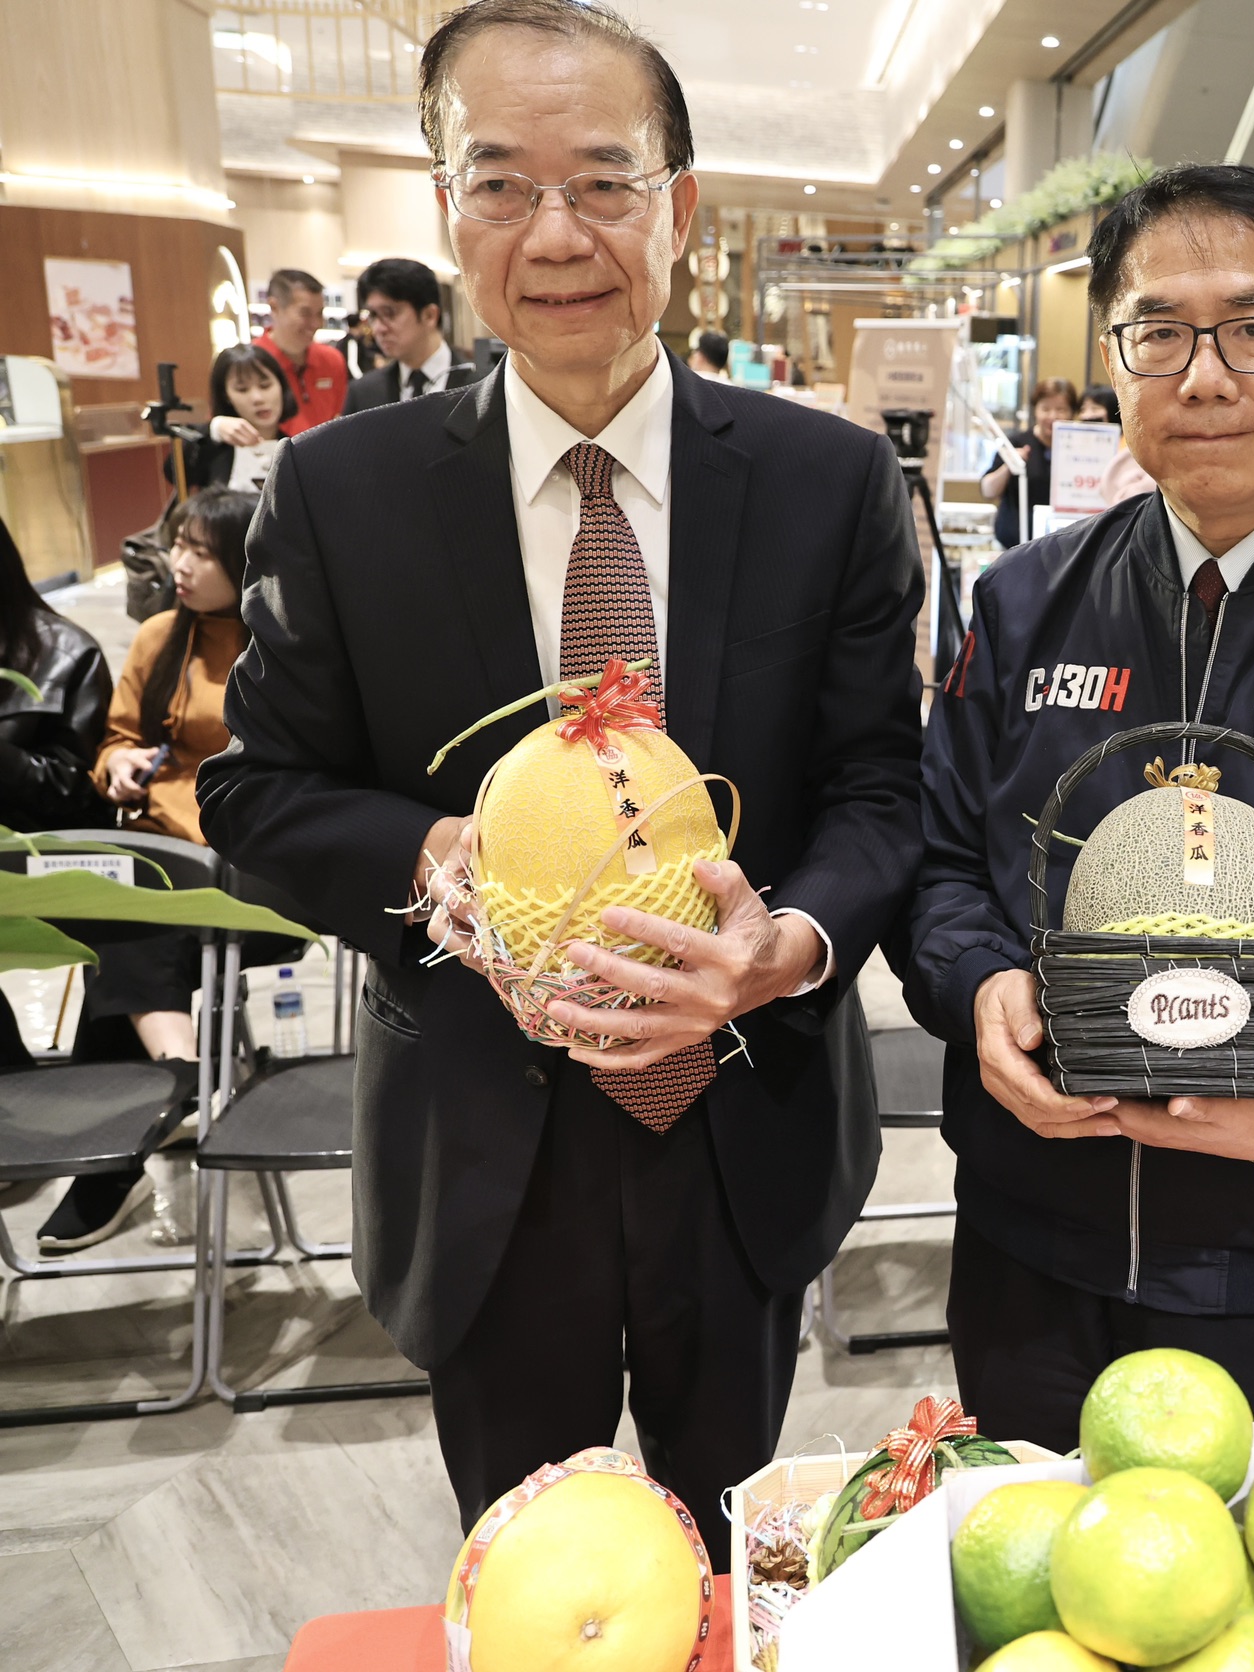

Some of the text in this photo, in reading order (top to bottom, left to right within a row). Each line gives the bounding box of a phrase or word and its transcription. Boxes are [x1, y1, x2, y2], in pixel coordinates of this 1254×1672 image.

[609, 769, 647, 850] 洋香瓜
[1189, 803, 1209, 861] 洋香瓜
[1151, 993, 1230, 1025] Plants
